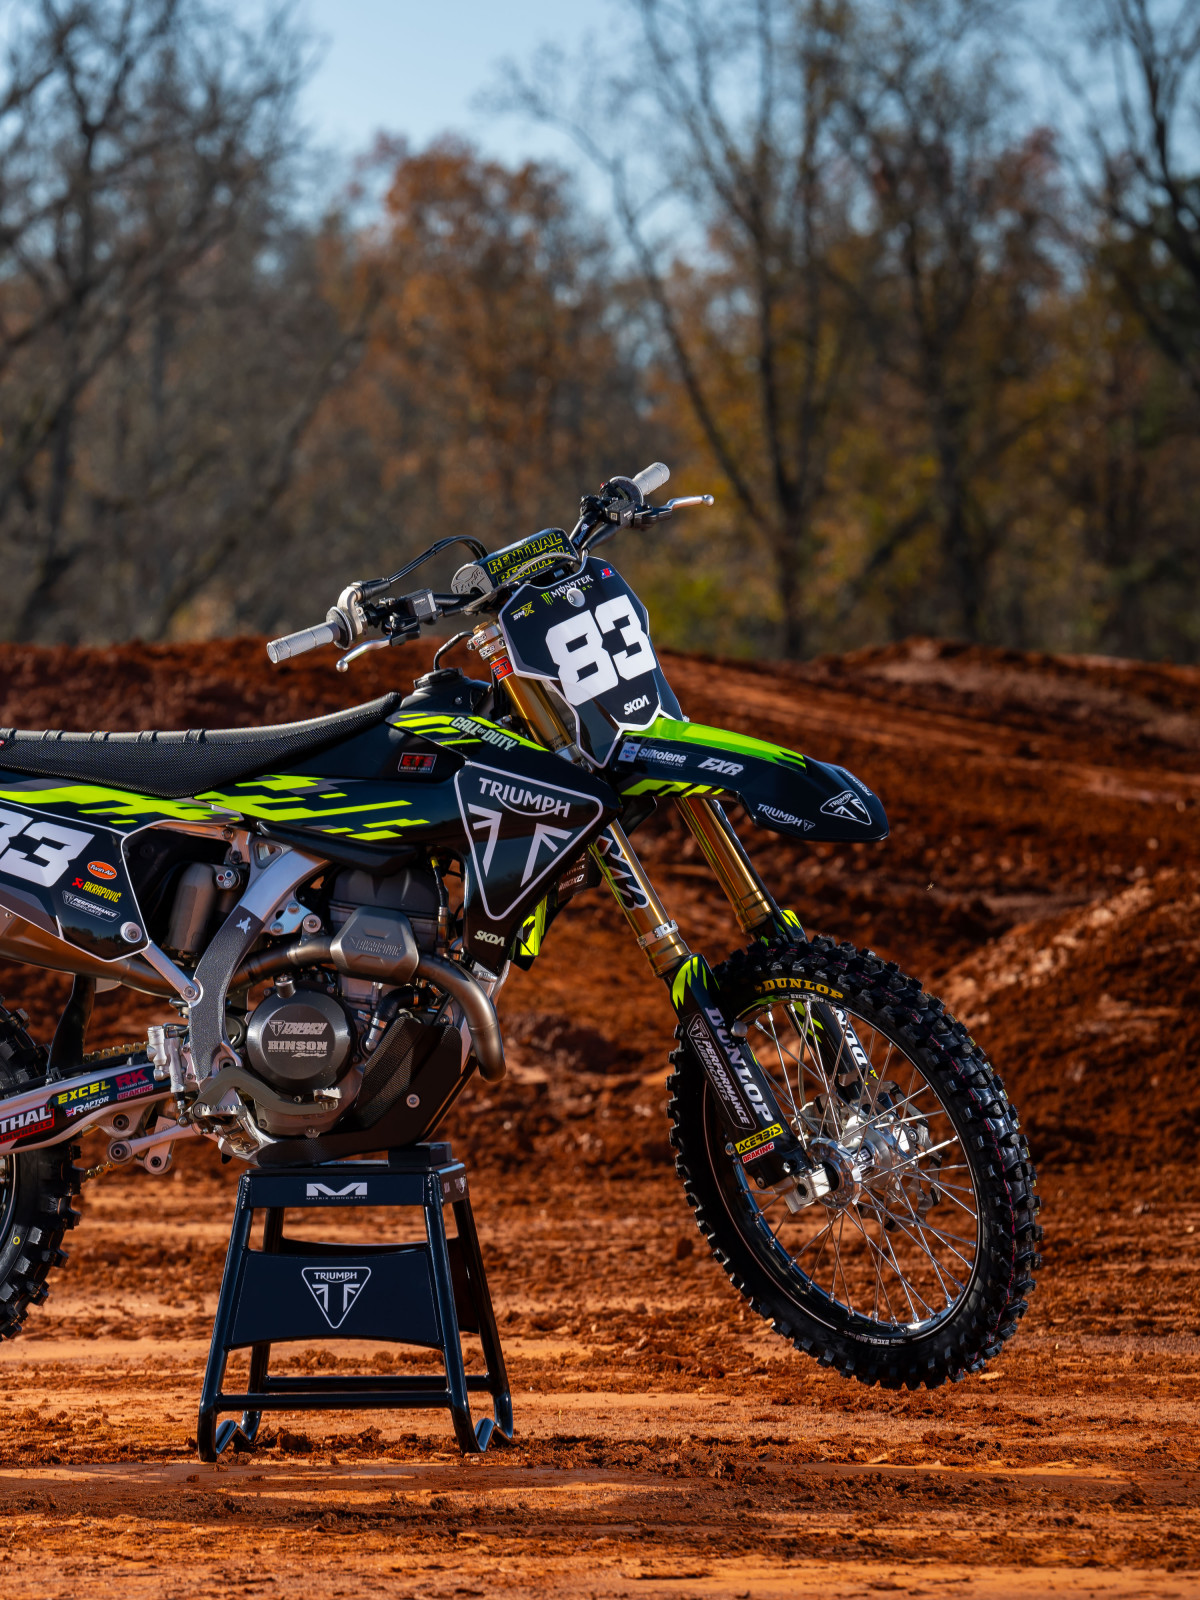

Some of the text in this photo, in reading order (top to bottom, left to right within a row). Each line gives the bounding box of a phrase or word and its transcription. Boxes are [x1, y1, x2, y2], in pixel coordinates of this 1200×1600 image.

[488, 533, 562, 574] RENTHAL
[550, 574, 594, 598] MONSTER
[545, 594, 657, 706] 83
[451, 716, 518, 751] CALL OF DUTY
[638, 748, 687, 763] Silkolene
[698, 757, 744, 777] FXR
[478, 777, 571, 818] TRIUMPH
[758, 803, 803, 827] TRIUMPH
[90, 864, 115, 876] Twin Air
[70, 900, 103, 917] LUBRICANTS
[73, 898, 117, 918] PERFORMANCE
[763, 977, 844, 999] DUNLOP
[268, 1040, 328, 1051] HINSON
[695, 1039, 731, 1102] LUBRICANTS
[705, 1007, 774, 1122] DUNLOP
[115, 1069, 148, 1088] RK
[702, 1040, 750, 1125] PERFORMANCE
[57, 1081, 111, 1105] EXCEL
[118, 1085, 153, 1099] BRAKING
[73, 1096, 110, 1115] RAPTOR
[742, 1142, 774, 1163] BRAKING
[314, 1271, 358, 1283] TRIUMPH
